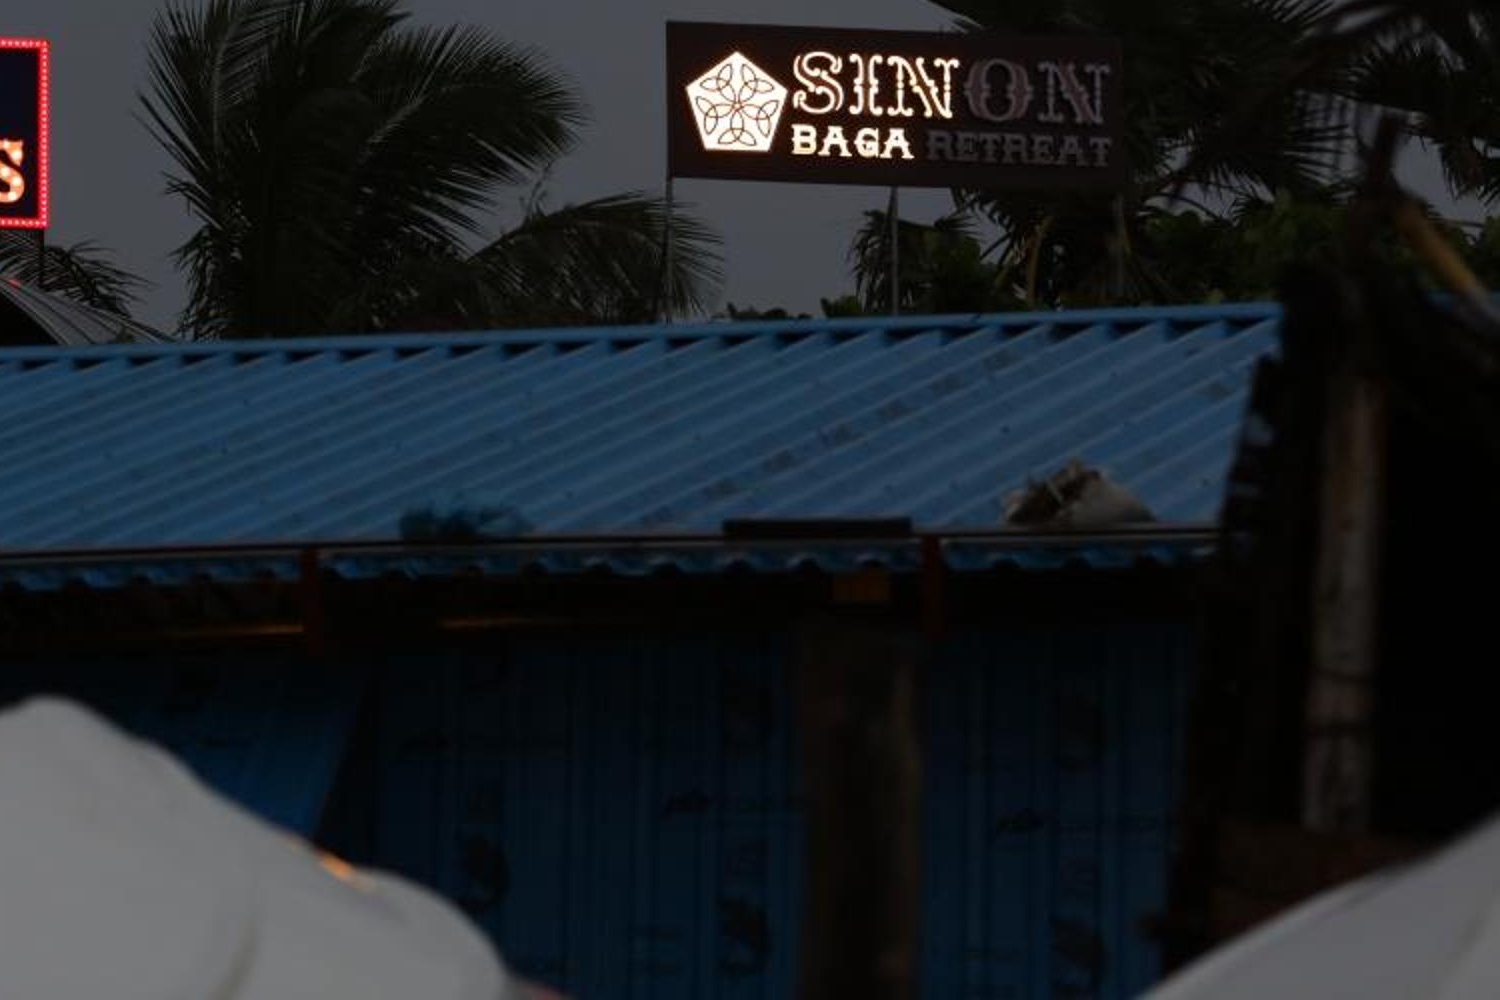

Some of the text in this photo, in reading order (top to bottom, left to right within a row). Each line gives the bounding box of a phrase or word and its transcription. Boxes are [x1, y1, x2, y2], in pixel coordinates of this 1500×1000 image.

[792, 50, 1111, 125] SINON
[791, 123, 1113, 168] BAGA RETREAT
